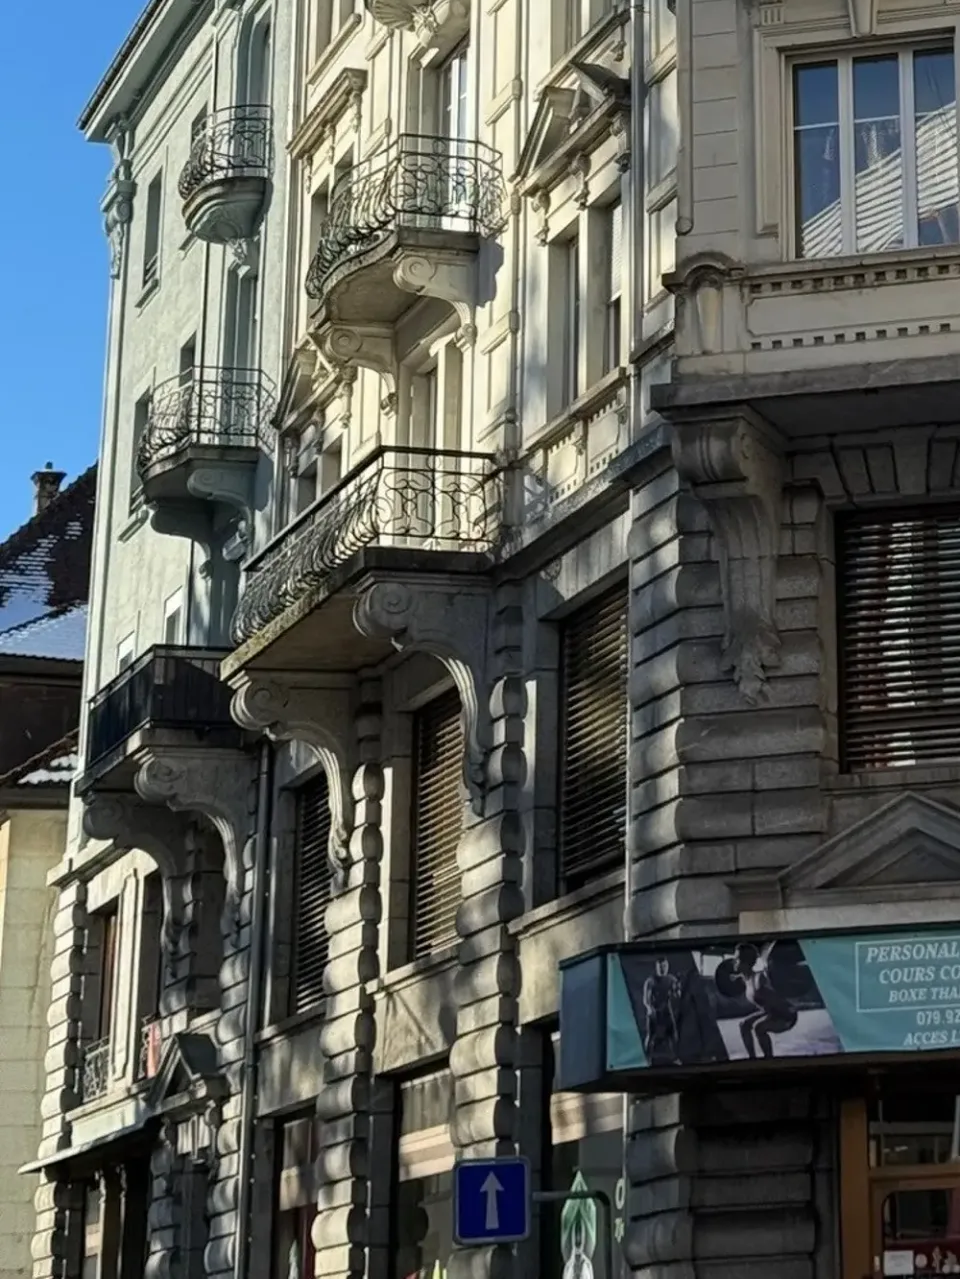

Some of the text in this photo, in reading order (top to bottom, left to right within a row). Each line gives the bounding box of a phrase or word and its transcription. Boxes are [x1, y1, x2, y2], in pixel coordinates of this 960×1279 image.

[865, 941, 960, 963] PERSONAL
[879, 966, 935, 984] COURS
[888, 987, 927, 1003] BOXE
